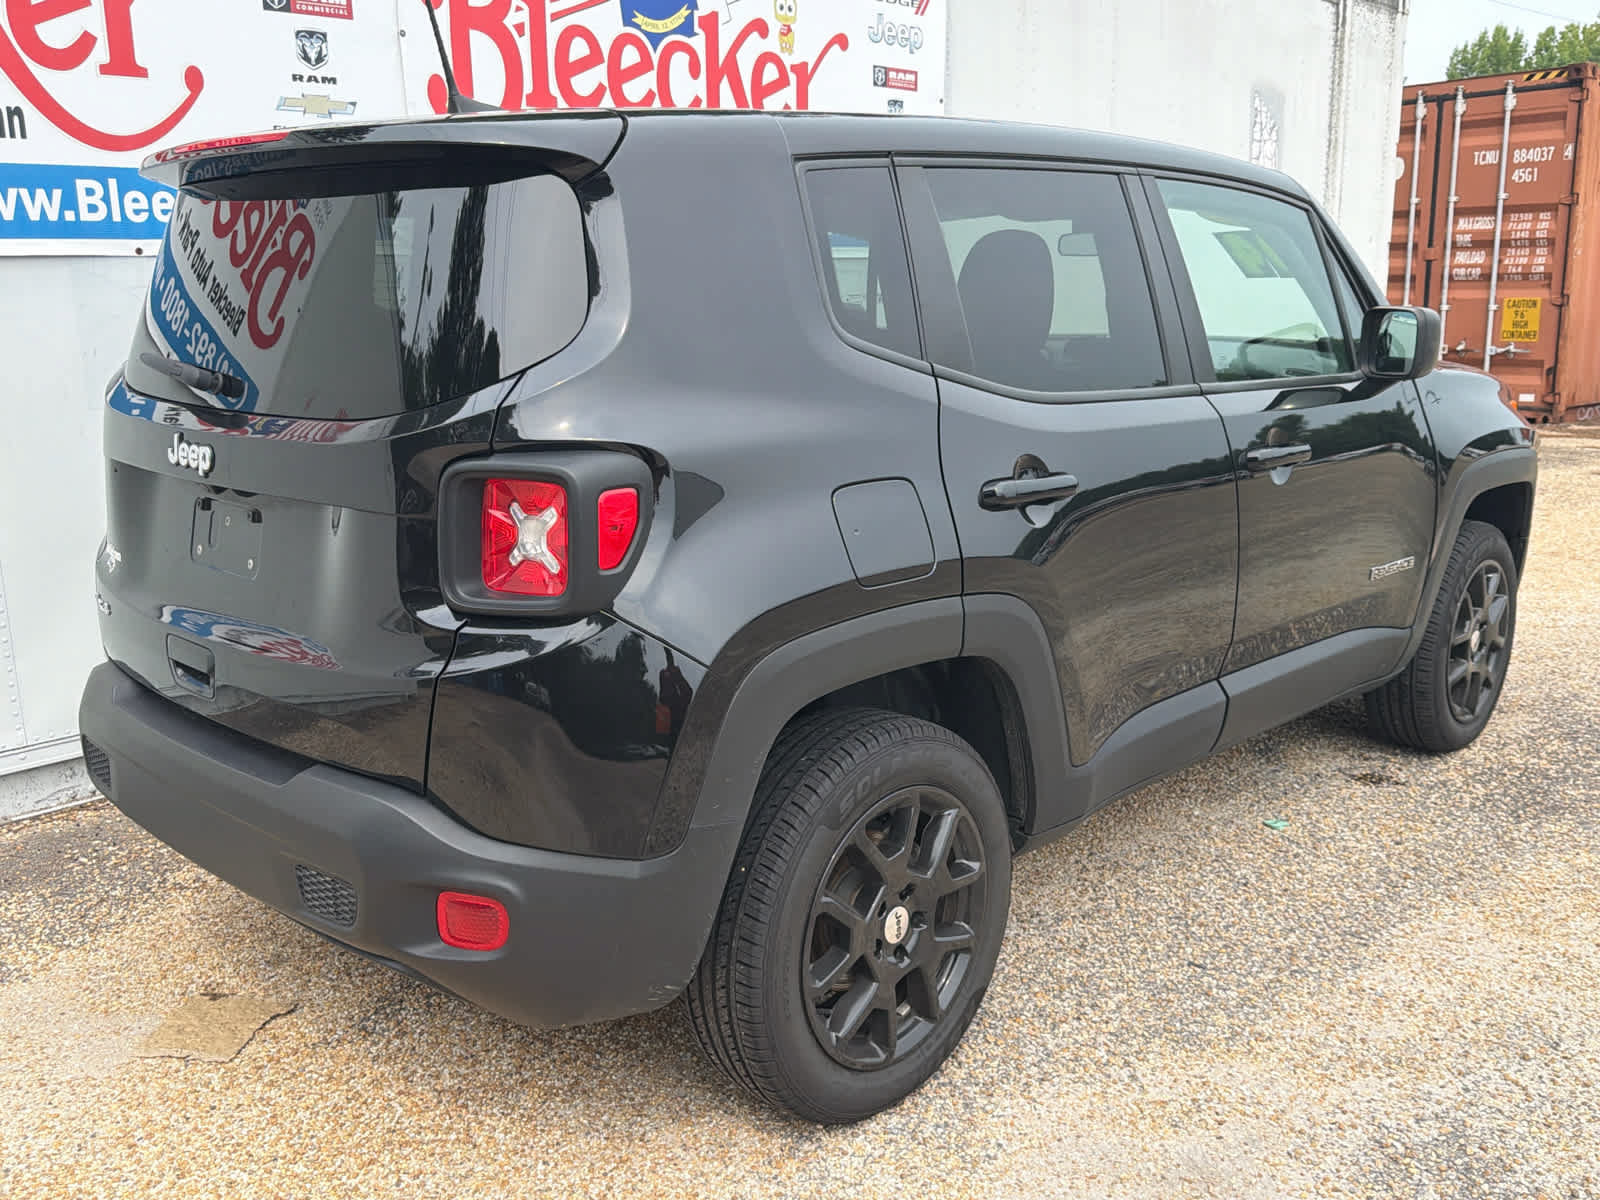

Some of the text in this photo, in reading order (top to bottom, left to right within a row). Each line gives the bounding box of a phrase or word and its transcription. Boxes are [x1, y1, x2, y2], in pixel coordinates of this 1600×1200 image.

[296, 4, 348, 15] COMMERCIAL
[867, 13, 924, 54] Jeep
[291, 73, 337, 85] RAM
[888, 70, 916, 82] RAM
[1473, 143, 1574, 166] TCNU 884037 4
[1511, 168, 1538, 183] 45G1
[1507, 299, 1537, 309] CAUTION
[1512, 320, 1529, 329] HIGH
[1503, 330, 1537, 339] CONTAINER
[167, 431, 216, 478] Jeep
[893, 910, 905, 940] Jeep
